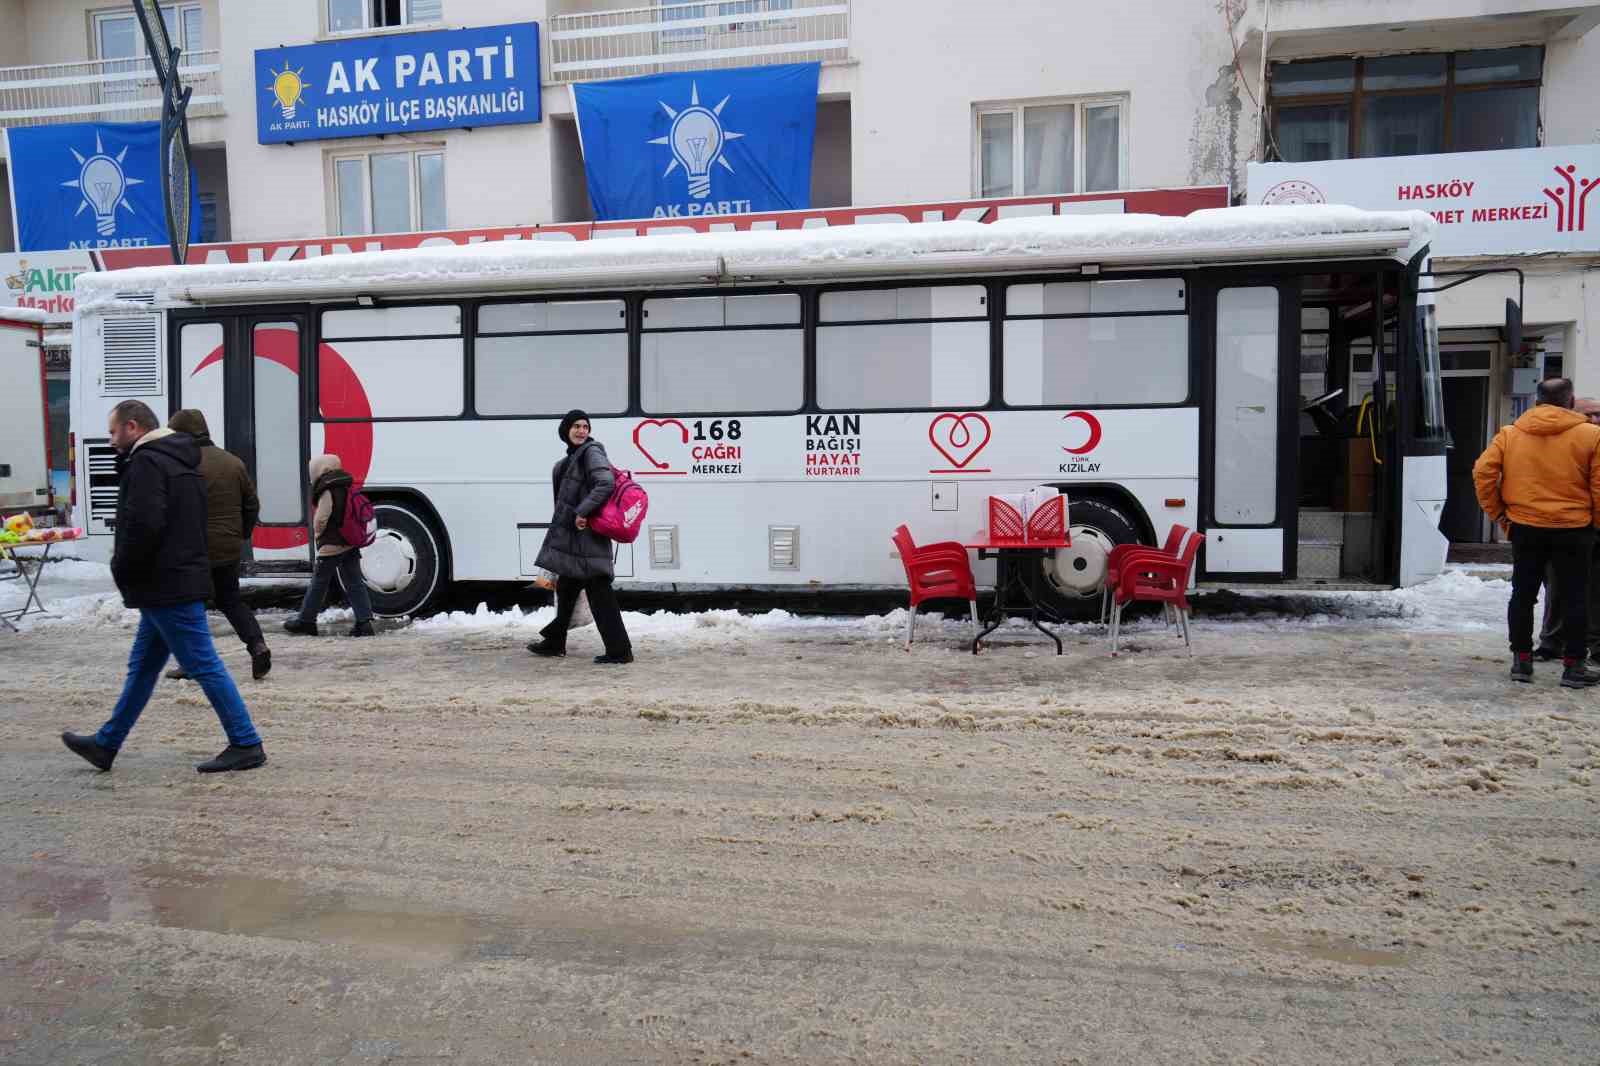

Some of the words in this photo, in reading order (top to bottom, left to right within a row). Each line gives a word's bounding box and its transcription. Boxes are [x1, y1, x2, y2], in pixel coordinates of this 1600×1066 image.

[326, 57, 380, 95] AK
[395, 36, 515, 88] PARTİ
[317, 101, 380, 128] HASKÖY
[385, 97, 420, 125] İLÇE
[425, 87, 524, 122] BAŞKANLIĞI
[270, 122, 282, 131] AK
[1398, 179, 1474, 200] HASKÖY
[653, 203, 681, 218] AK
[1471, 202, 1548, 222] MERKEZİ
[693, 420, 742, 441] 168
[806, 415, 860, 435] KAN
[692, 443, 741, 463] ÇAĞRI
[806, 436, 861, 453] BAĞIŞI
[692, 462, 742, 474] MERKEZİ
[806, 453, 861, 465] HAYAT
[1059, 463, 1101, 473] KIZILAY
[806, 467, 860, 476] KURTARIR
